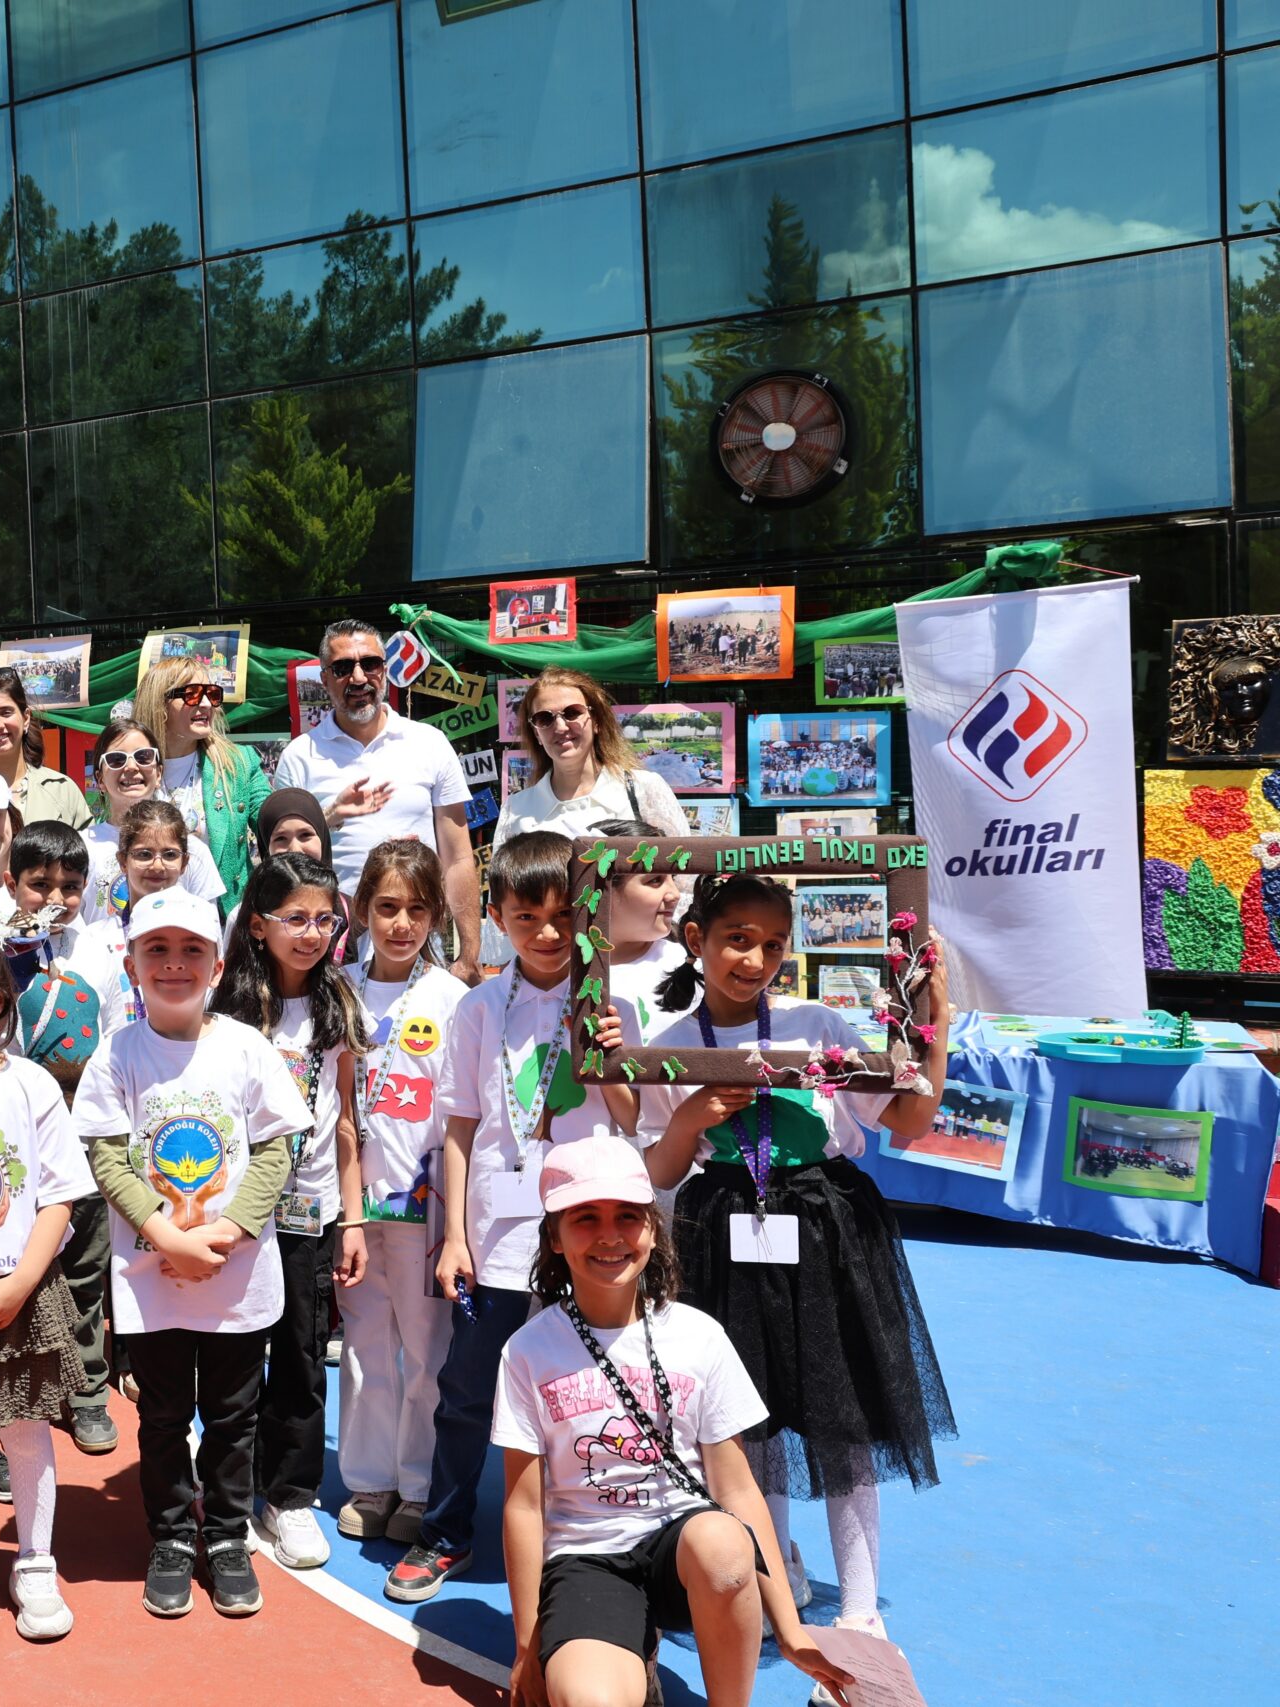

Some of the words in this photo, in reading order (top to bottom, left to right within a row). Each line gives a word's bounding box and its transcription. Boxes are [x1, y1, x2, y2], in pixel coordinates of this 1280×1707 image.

[983, 813, 1080, 848] final
[813, 837, 876, 866] OKUL
[888, 844, 928, 869] EKO
[944, 845, 1105, 877] okulları
[156, 1120, 195, 1152] ORTADOĞU
[539, 1367, 617, 1424] HELLO
